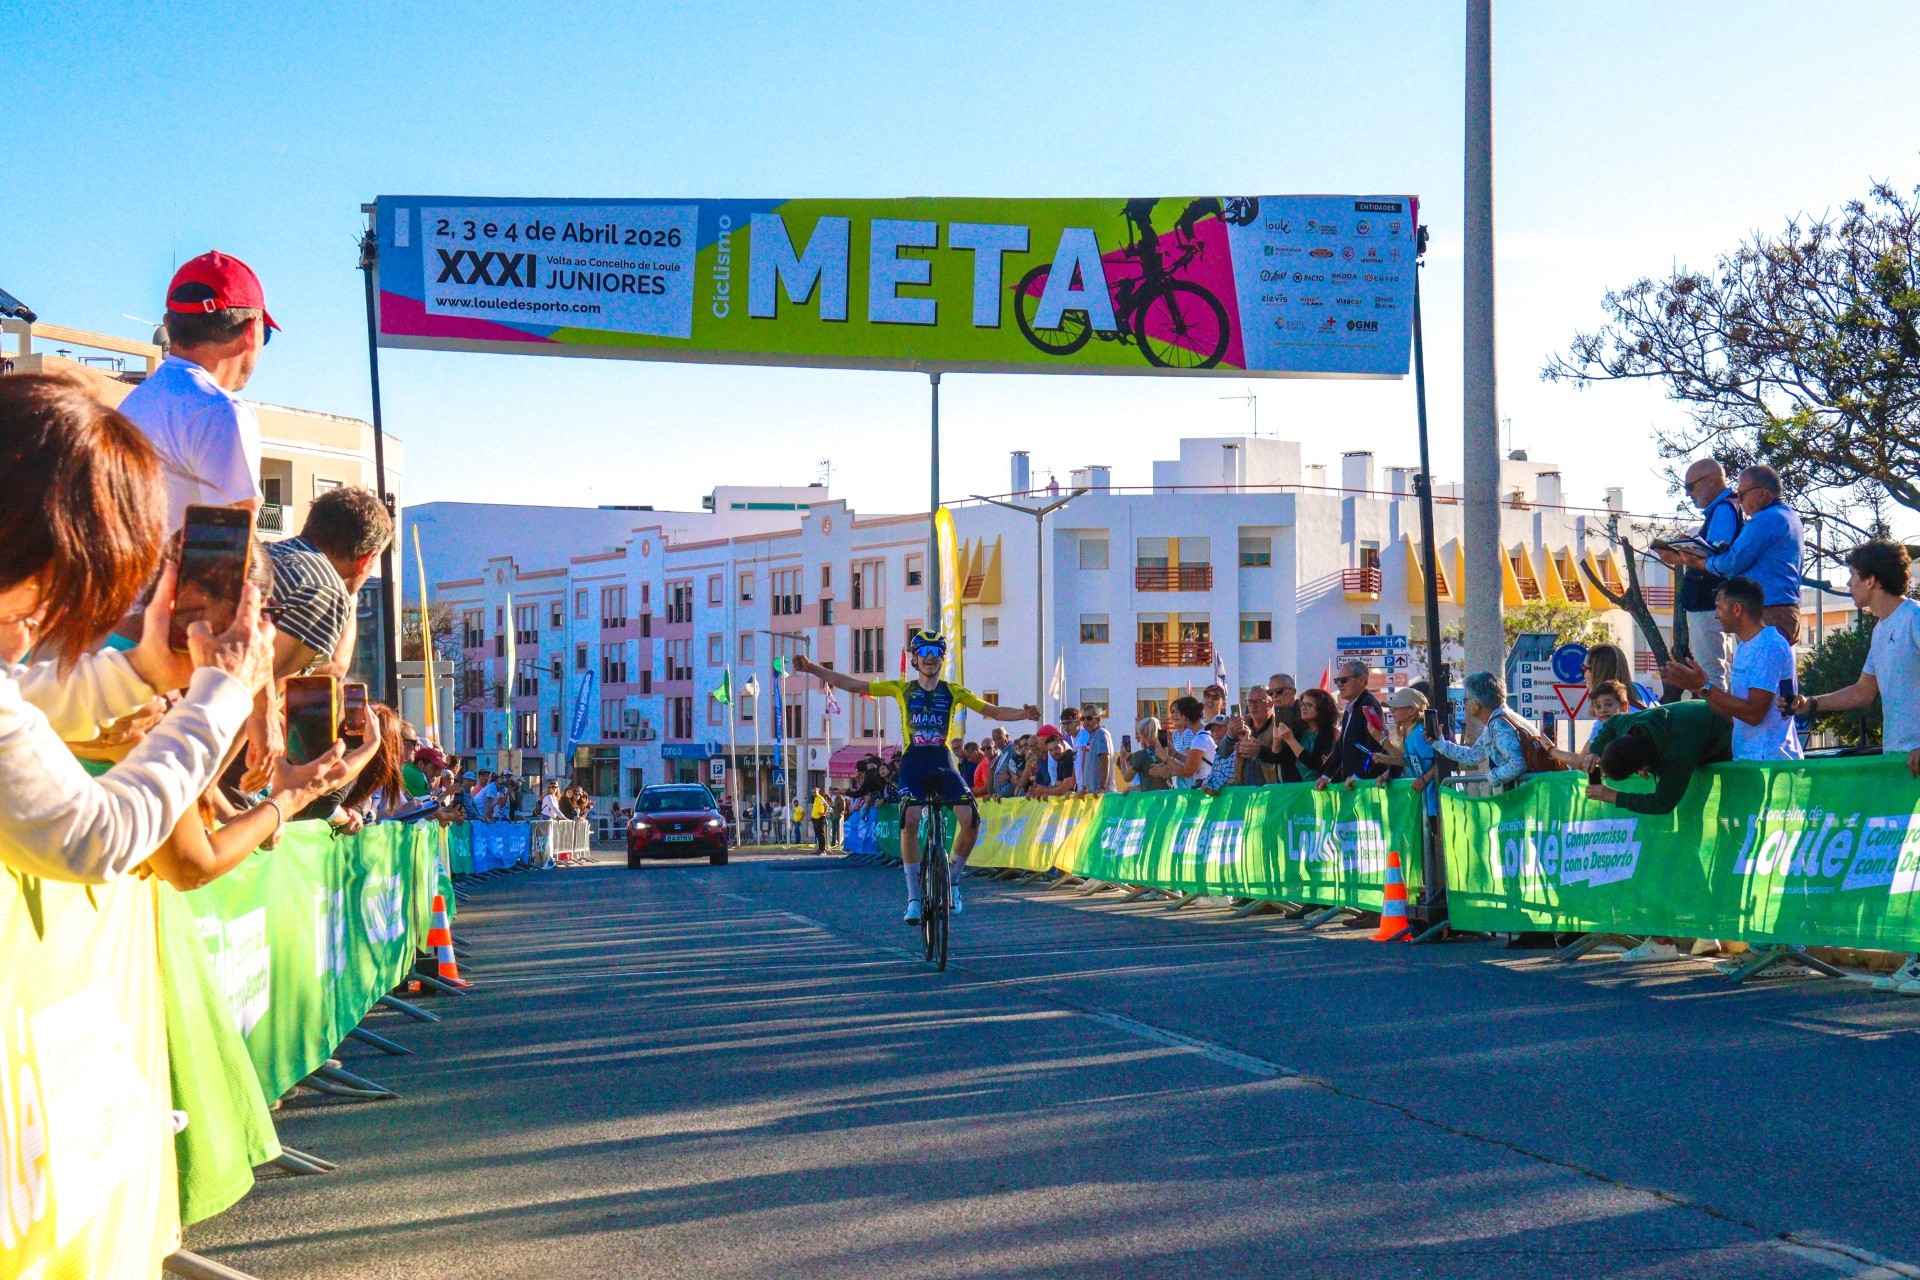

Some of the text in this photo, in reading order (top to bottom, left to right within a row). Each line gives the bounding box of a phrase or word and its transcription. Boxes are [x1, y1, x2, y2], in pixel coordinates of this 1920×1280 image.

[1360, 203, 1397, 211] ENTIDADES:
[436, 218, 682, 248] 2, 3 e 4 de Abril 2026
[436, 248, 537, 288] XXXI
[546, 255, 681, 272] Volta ao Concelho de Loulé
[712, 214, 732, 319] Ciclismo
[748, 212, 1118, 331] META
[545, 269, 666, 295] JUNIORES
[1304, 274, 1325, 282] PACTO
[436, 296, 601, 314] www.louledesporto.com
[1355, 320, 1379, 330] GNR
[1338, 640, 1360, 648] Hospital
[1526, 815, 1536, 830] de
[1760, 804, 1823, 821] Concelho de
[1565, 826, 1628, 849] Compromisso
[1732, 812, 1862, 878] Loulé
[1489, 819, 1559, 879] Loulé
[1564, 850, 1634, 874] com o Desporto
[1855, 857, 1888, 875] com
[1888, 860, 1898, 874] o
